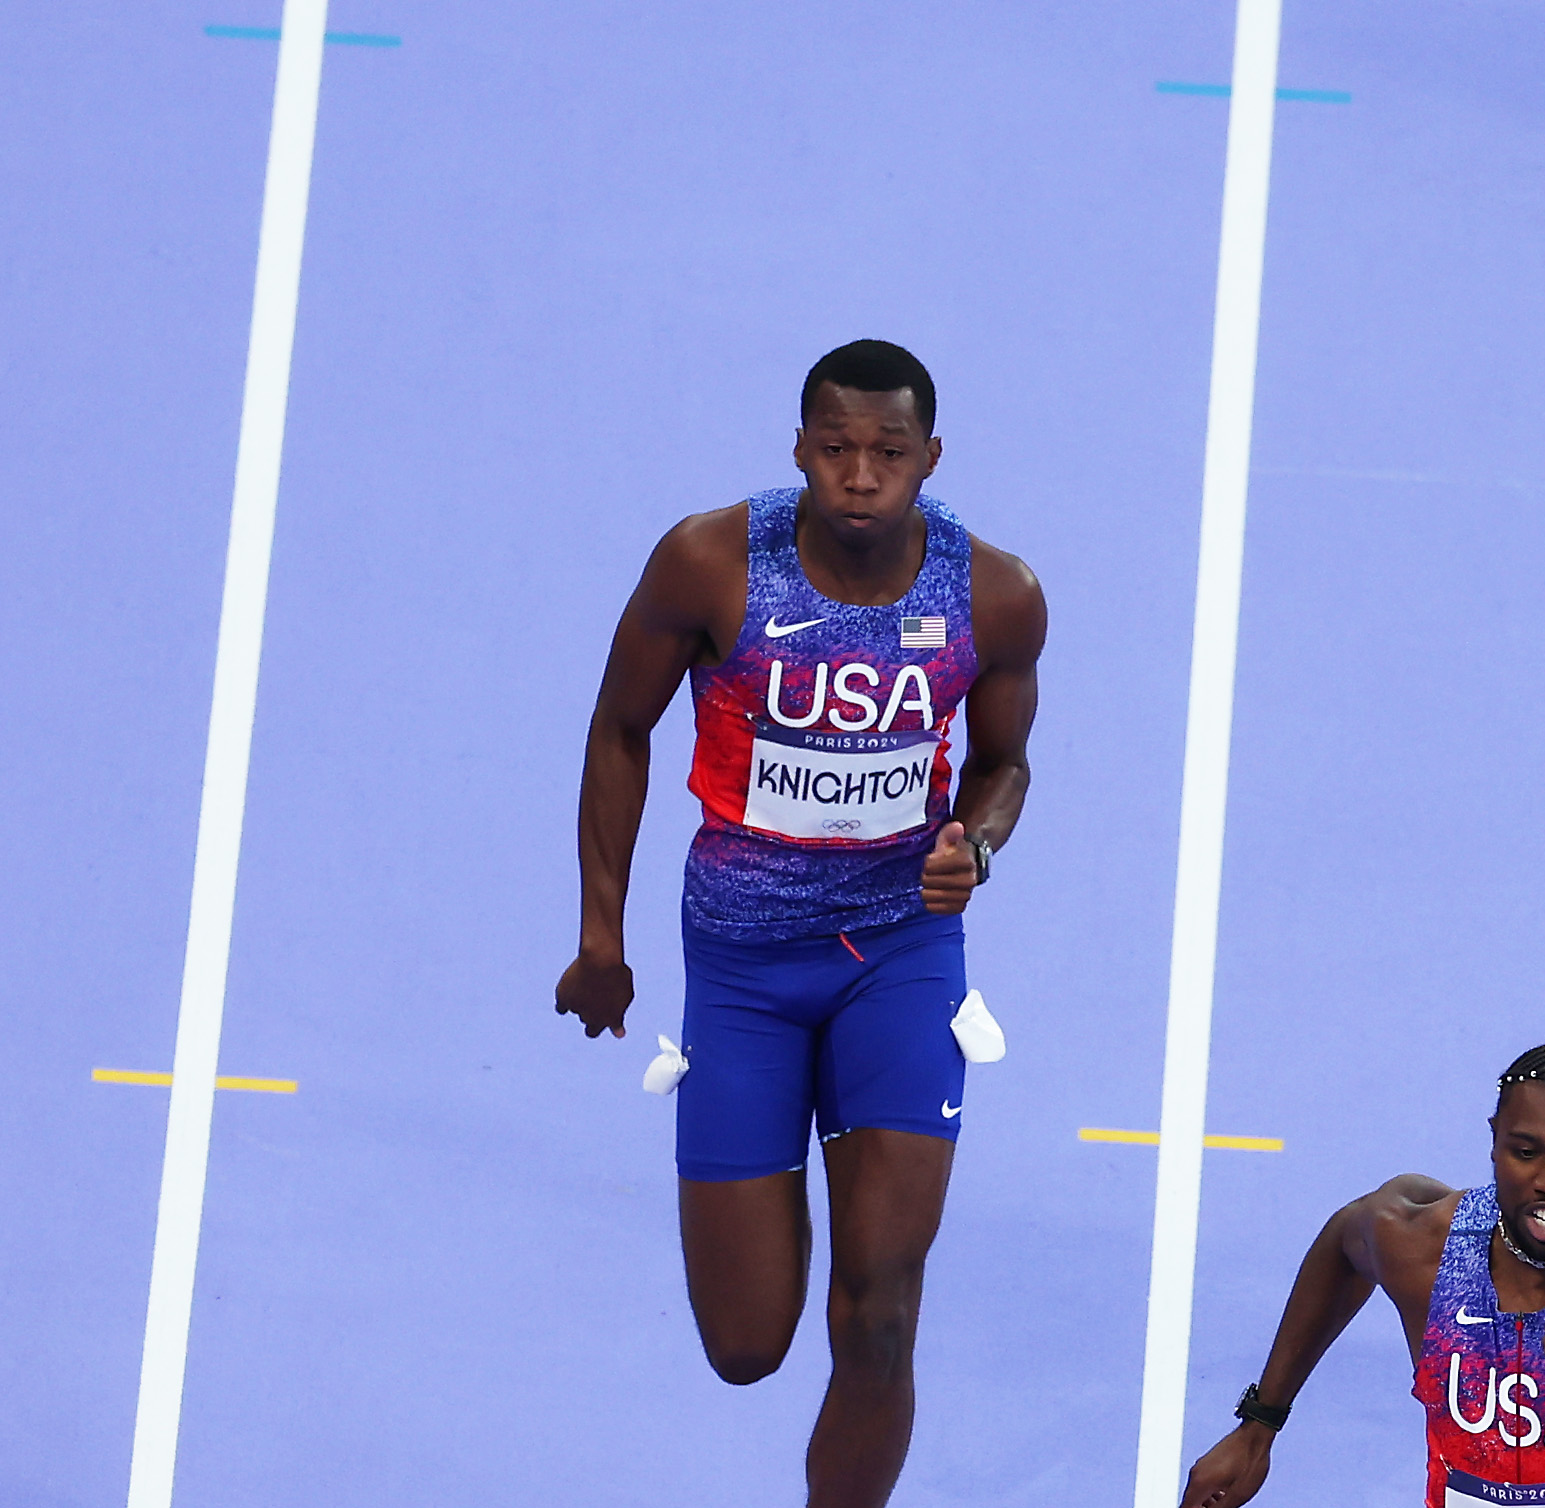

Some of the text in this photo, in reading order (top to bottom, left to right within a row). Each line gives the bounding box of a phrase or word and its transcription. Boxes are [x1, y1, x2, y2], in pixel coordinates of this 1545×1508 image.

[767, 660, 934, 732] USA
[805, 735, 898, 749] PARIS 2024
[757, 757, 928, 805] KNIGHTON
[1482, 1483, 1522, 1500] PARIS
